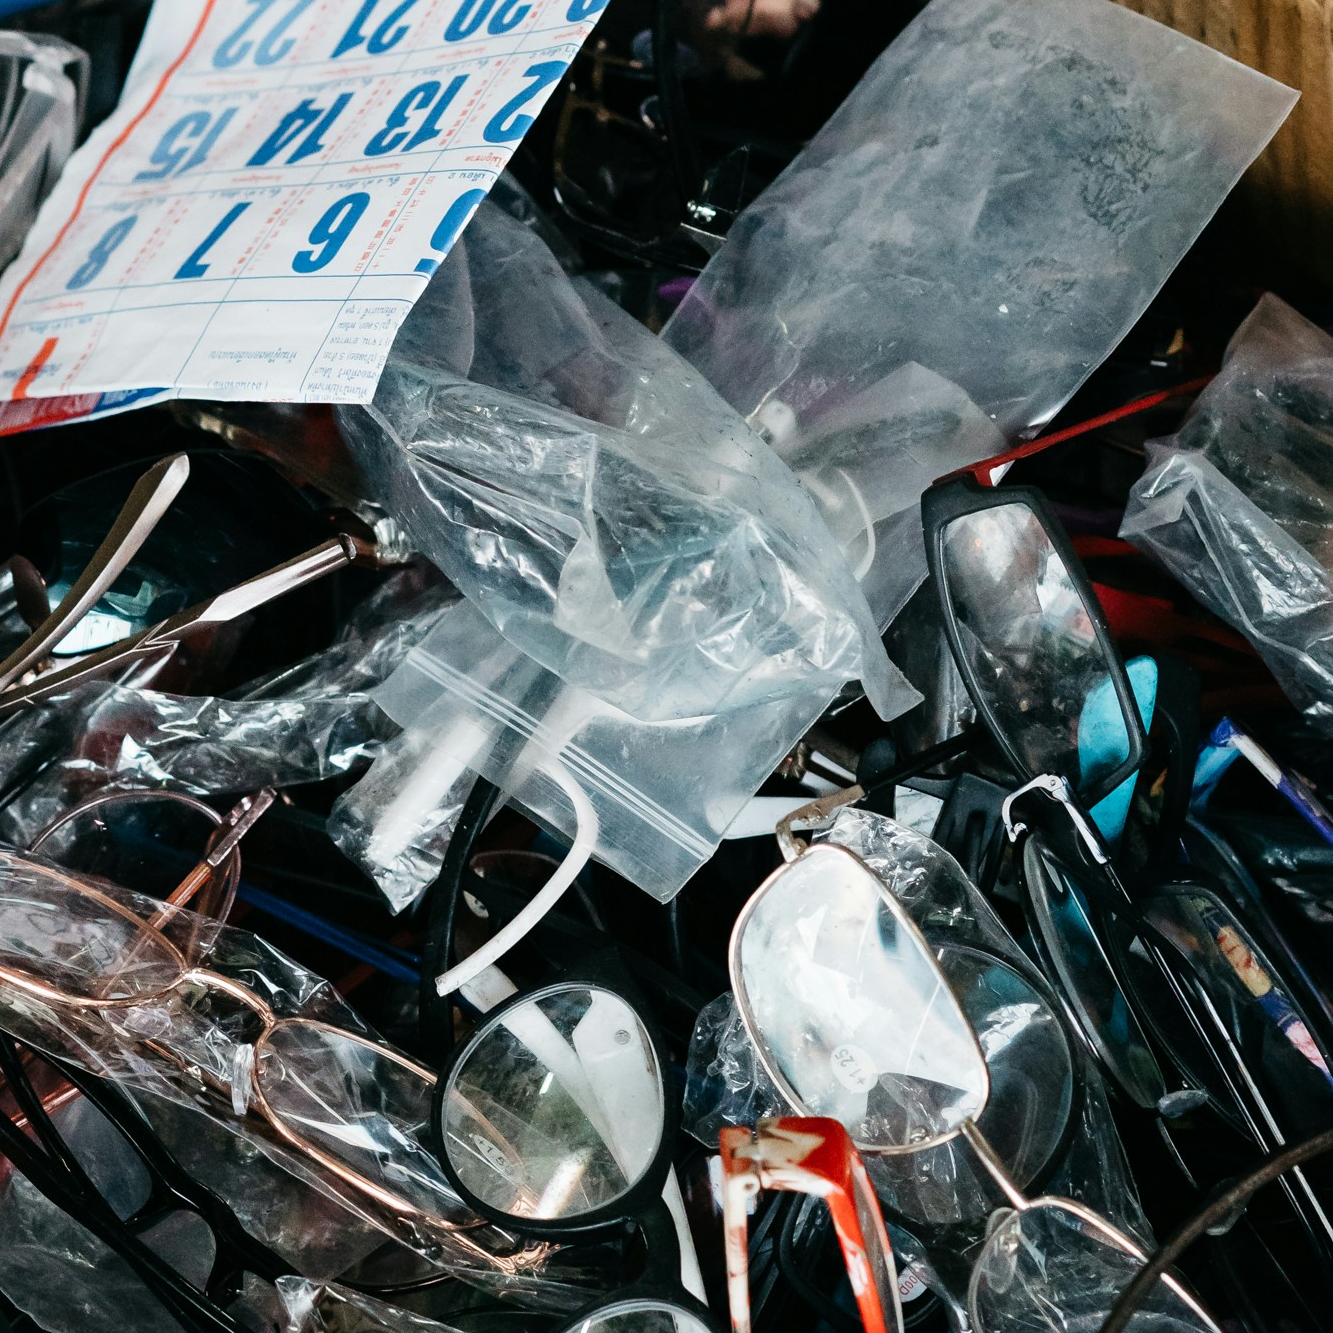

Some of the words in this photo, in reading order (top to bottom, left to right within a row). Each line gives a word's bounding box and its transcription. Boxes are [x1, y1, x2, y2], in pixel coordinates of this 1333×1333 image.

[245, 91, 355, 169] 14
[363, 73, 470, 157] 13
[482, 59, 571, 144] 2
[136, 106, 237, 181] 15
[66, 215, 138, 290] 8
[172, 201, 251, 281] 7
[290, 191, 372, 275] 6
